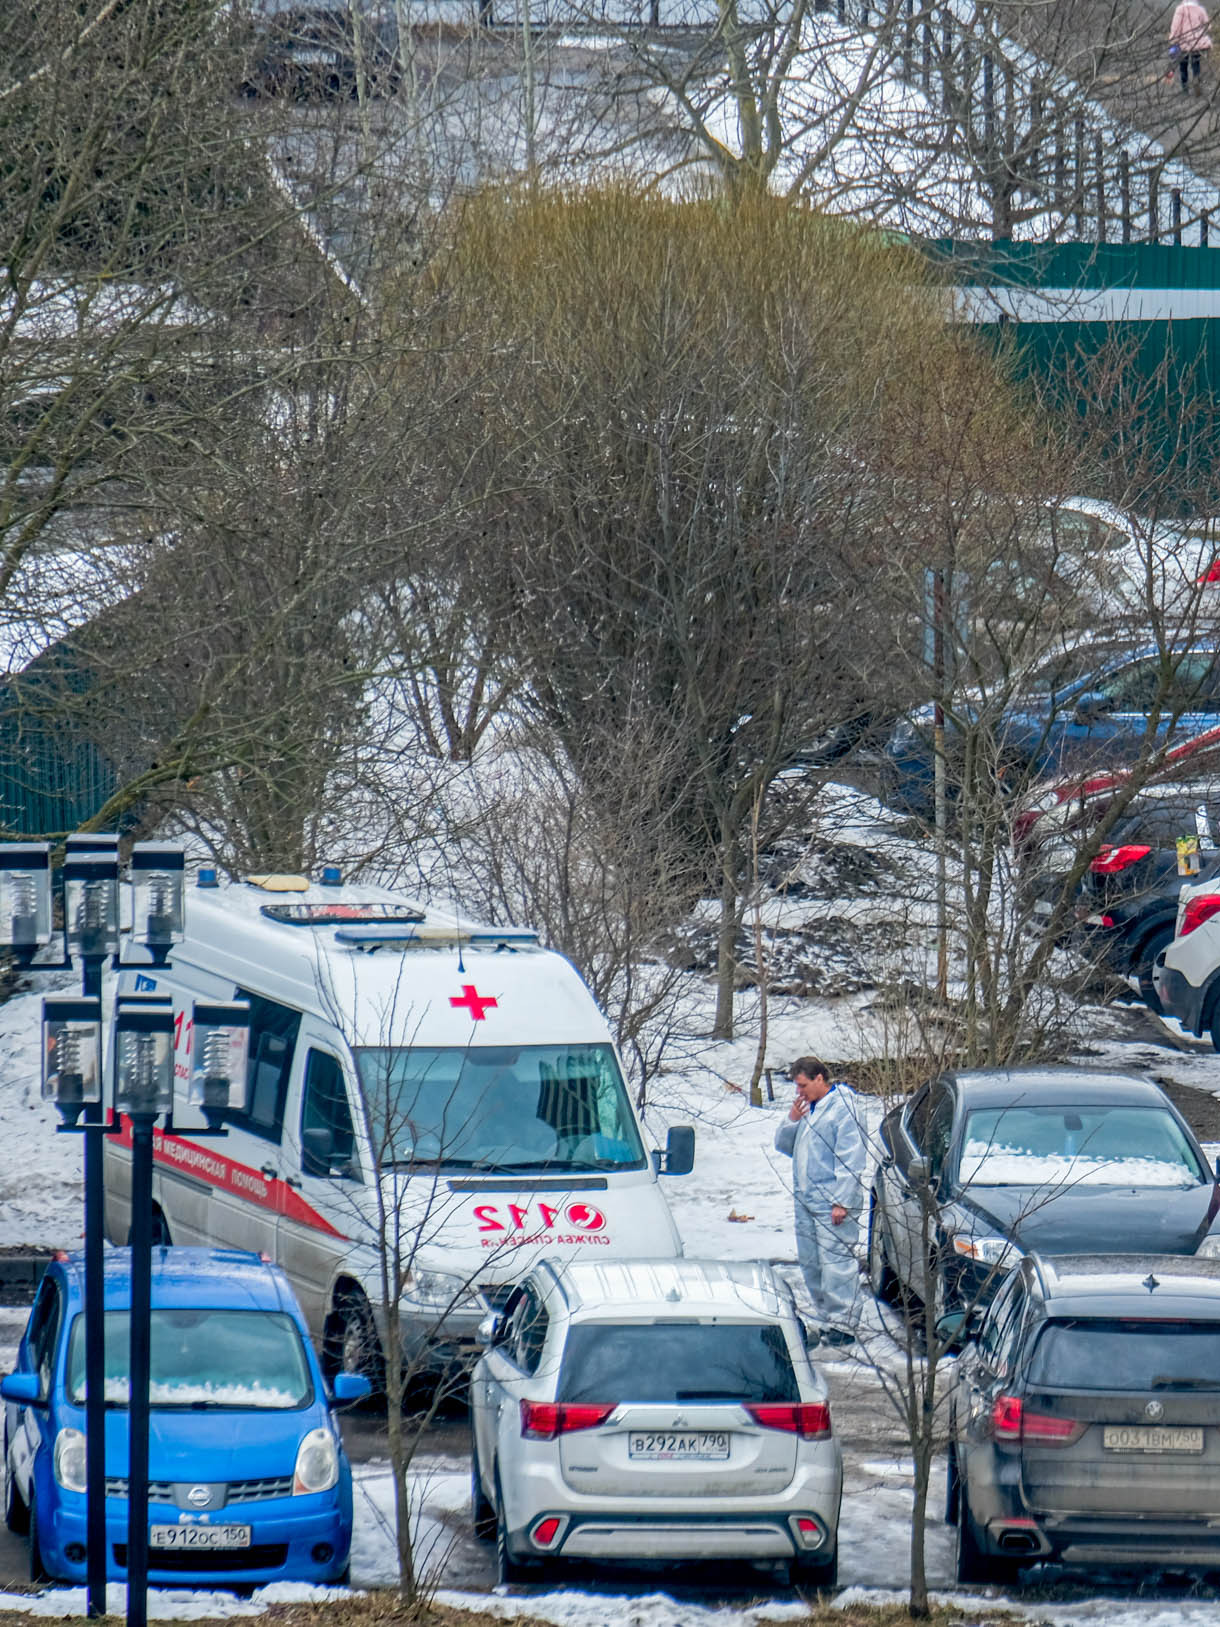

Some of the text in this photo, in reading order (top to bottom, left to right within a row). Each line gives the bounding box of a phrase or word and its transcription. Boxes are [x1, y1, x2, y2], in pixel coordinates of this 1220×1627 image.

[163, 1140, 227, 1181] МЕДИЦИНСКАЯ
[231, 1169, 269, 1198] ПОМОЩЬ
[635, 1434, 725, 1452] В292АК 790
[156, 1527, 246, 1545] Е912ОС 150
